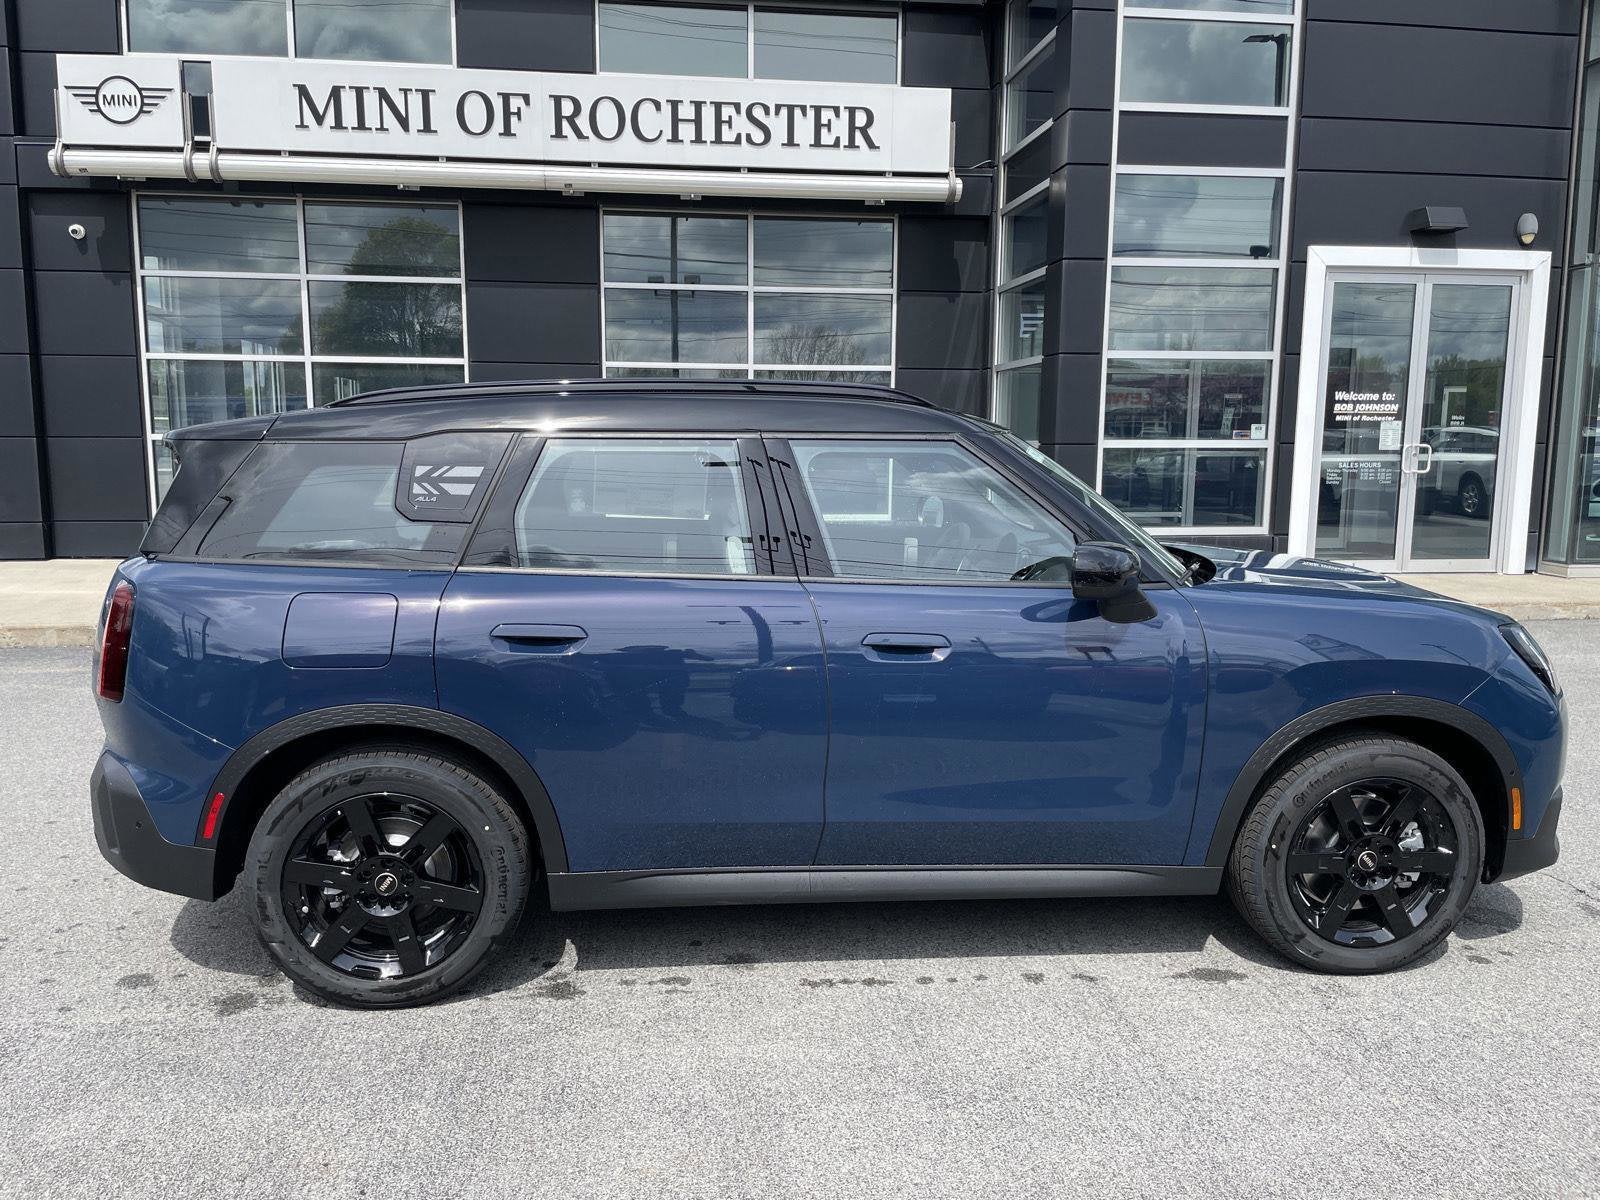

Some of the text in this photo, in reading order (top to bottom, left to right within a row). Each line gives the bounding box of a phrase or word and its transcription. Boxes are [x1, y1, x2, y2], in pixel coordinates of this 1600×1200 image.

[102, 94, 138, 107] MINI
[293, 84, 880, 150] MINI OF ROCHESTER
[1334, 391, 1396, 401] Welcome to:
[1334, 403, 1399, 412] BOB JOHNSON
[379, 876, 393, 892] MINI
